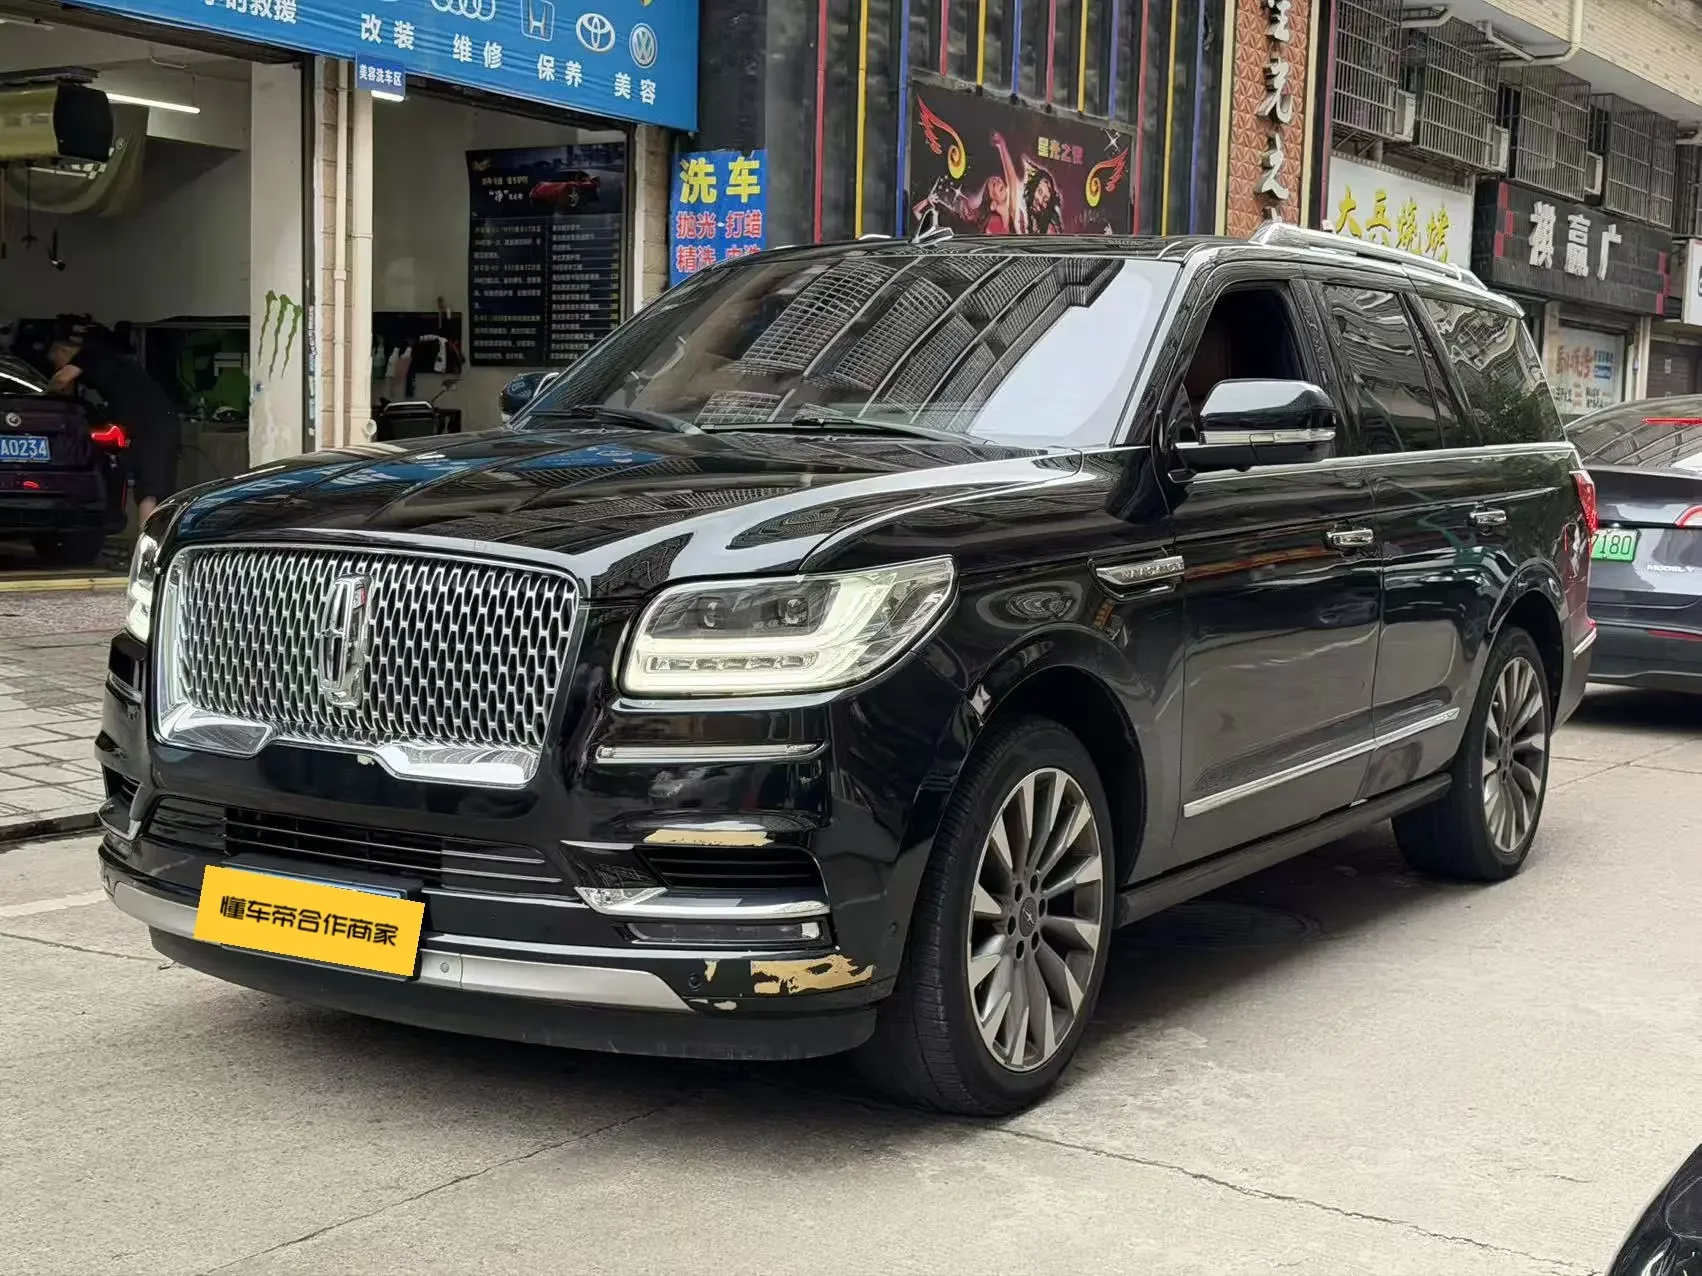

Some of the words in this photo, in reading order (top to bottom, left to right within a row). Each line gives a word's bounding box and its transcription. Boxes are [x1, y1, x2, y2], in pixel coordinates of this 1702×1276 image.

[359, 64, 402, 87] 美容洗车区
[360, 13, 415, 50] 改装
[452, 33, 503, 69] 维修
[537, 53, 583, 88] 保养
[614, 72, 656, 105] 美容
[680, 156, 761, 204] 洗车
[1, 439, 48, 456] A0234
